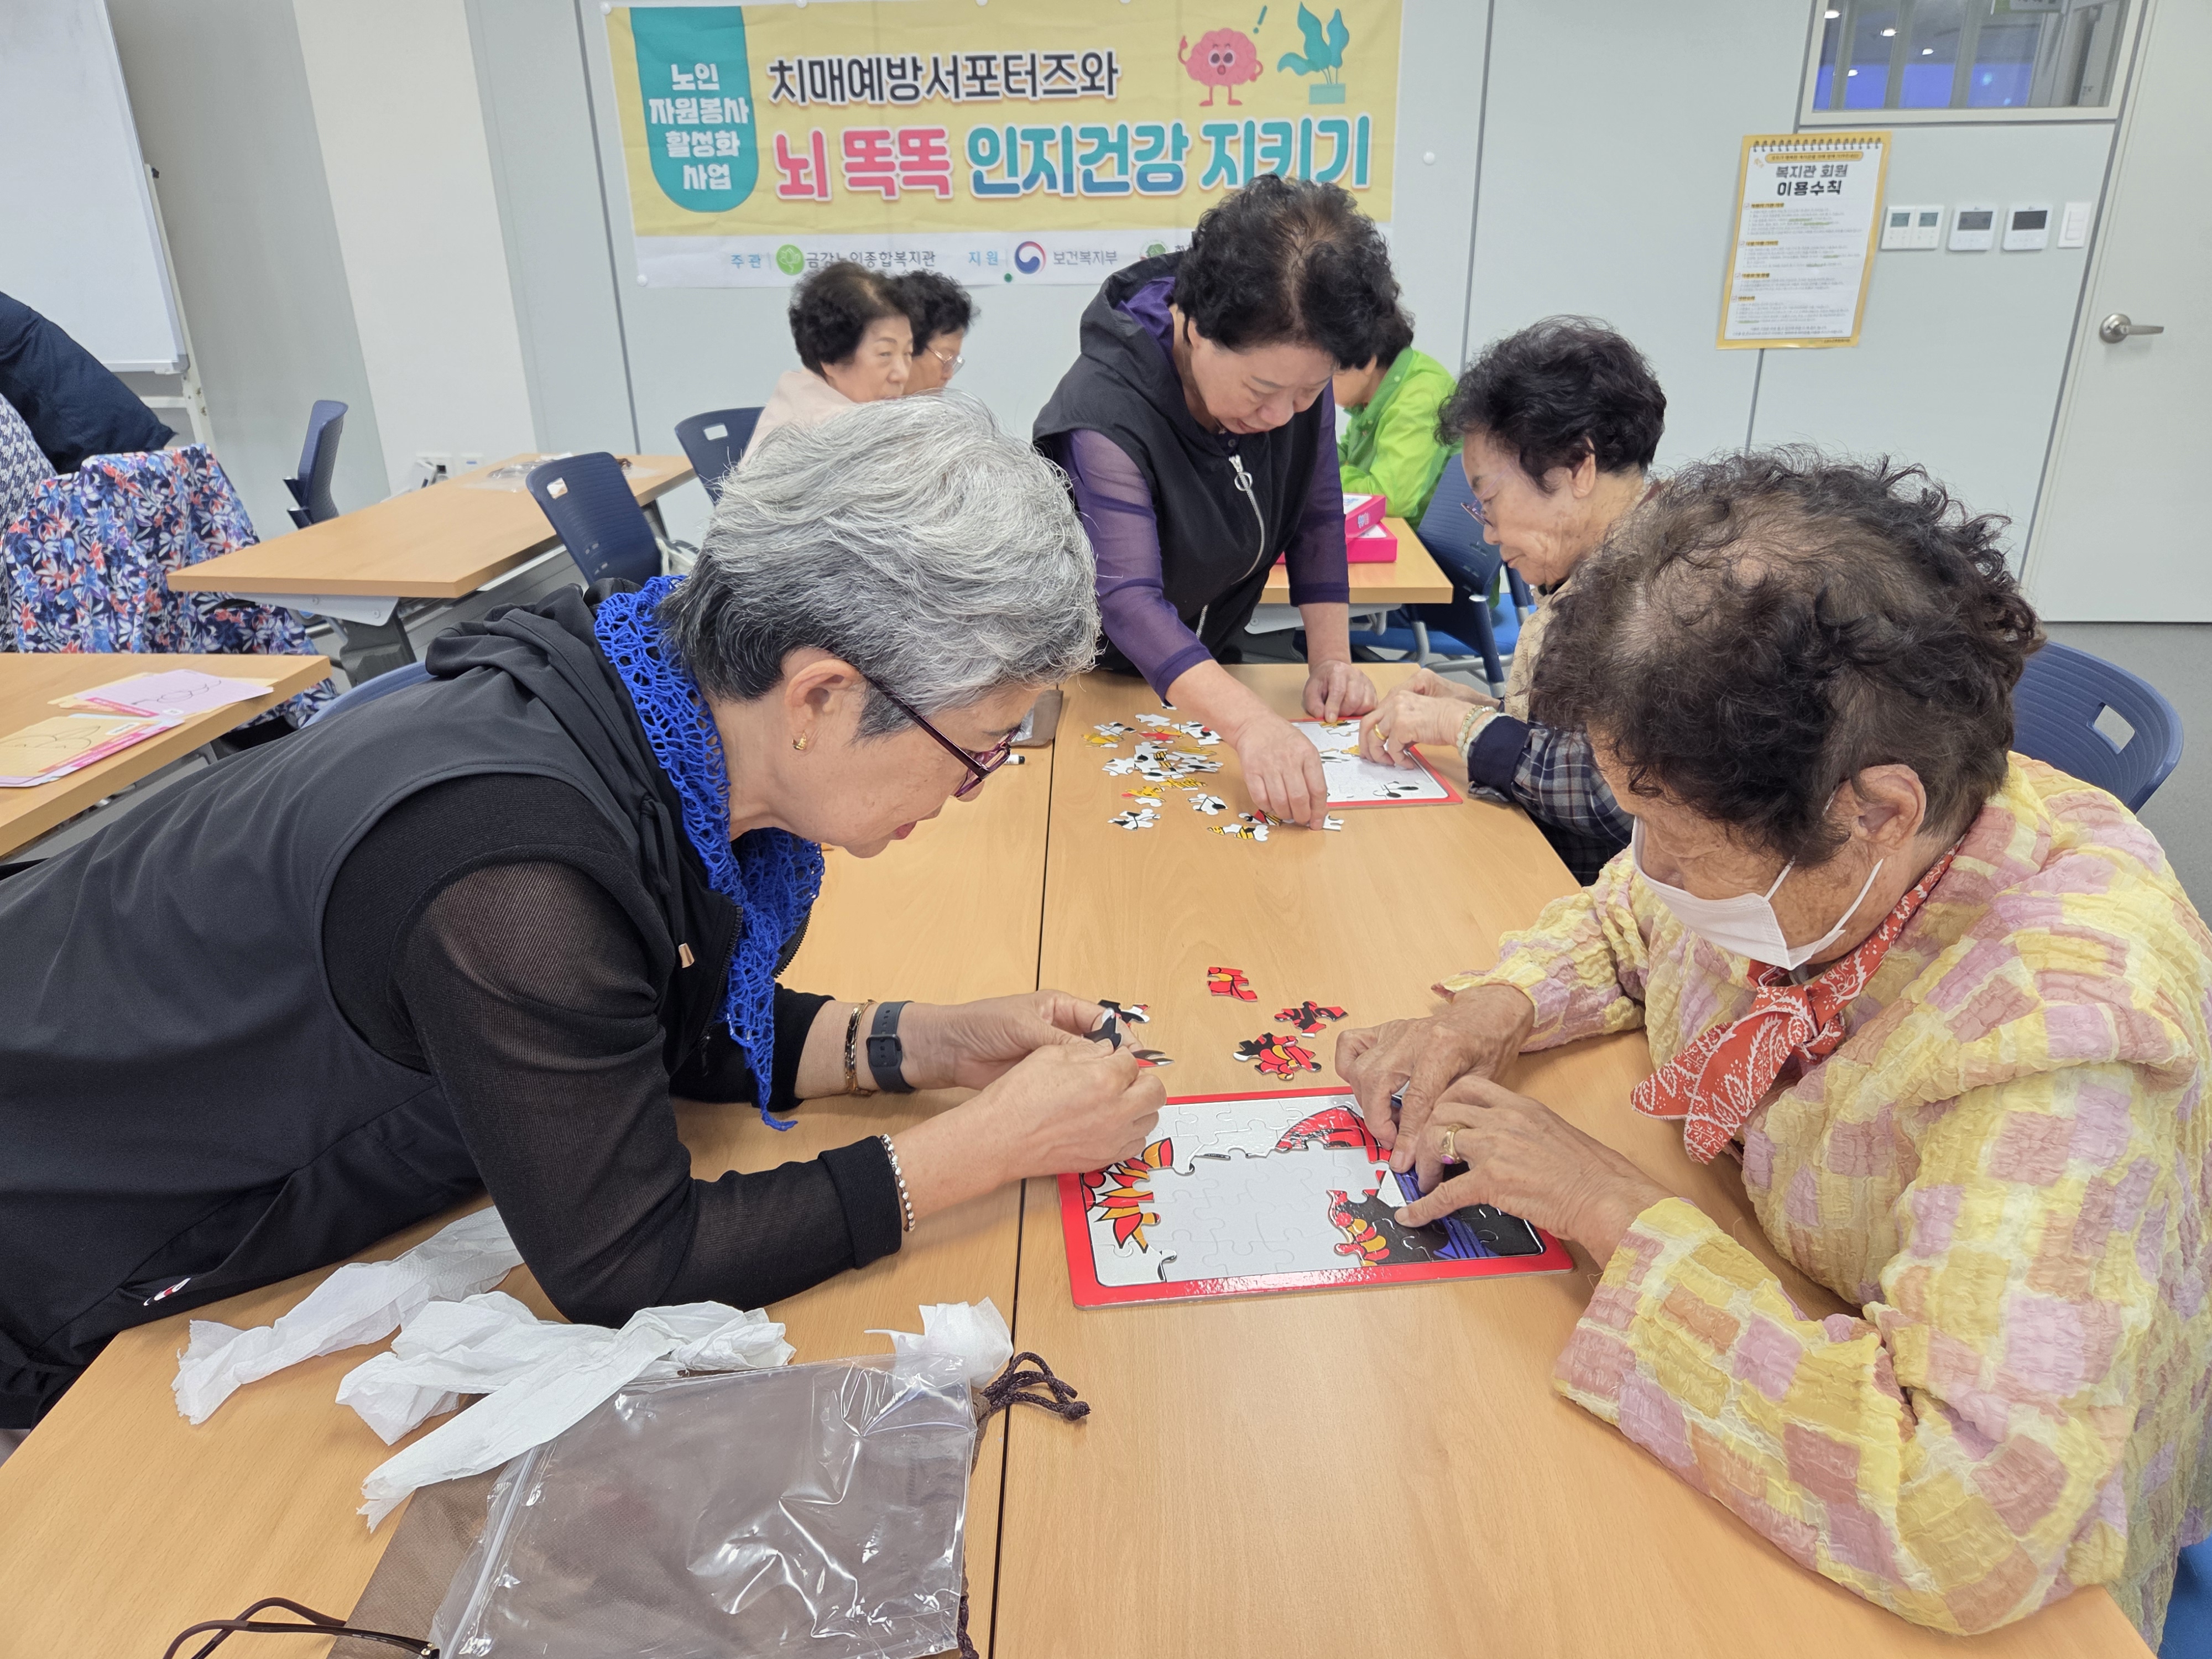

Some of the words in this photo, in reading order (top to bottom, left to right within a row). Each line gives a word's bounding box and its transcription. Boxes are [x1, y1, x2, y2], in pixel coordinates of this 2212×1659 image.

[670, 63, 720, 91] 노인
[769, 51, 1119, 103] 치매예방서포터즈와
[649, 97, 749, 124] 자원봉사
[665, 130, 740, 158] 활성화
[775, 129, 829, 198] 뇌
[844, 128, 952, 197] 똑똑
[968, 122, 1189, 195] 인지건강
[1199, 115, 1370, 188] 지키기
[682, 164, 732, 190] 사업
[1776, 165, 1816, 178] 복지관
[1820, 164, 1848, 178] 회원
[1777, 179, 1842, 196] 이용수칙
[805, 251, 936, 269] 금강인종합복지관
[1053, 250, 1118, 266] 보건복지부
